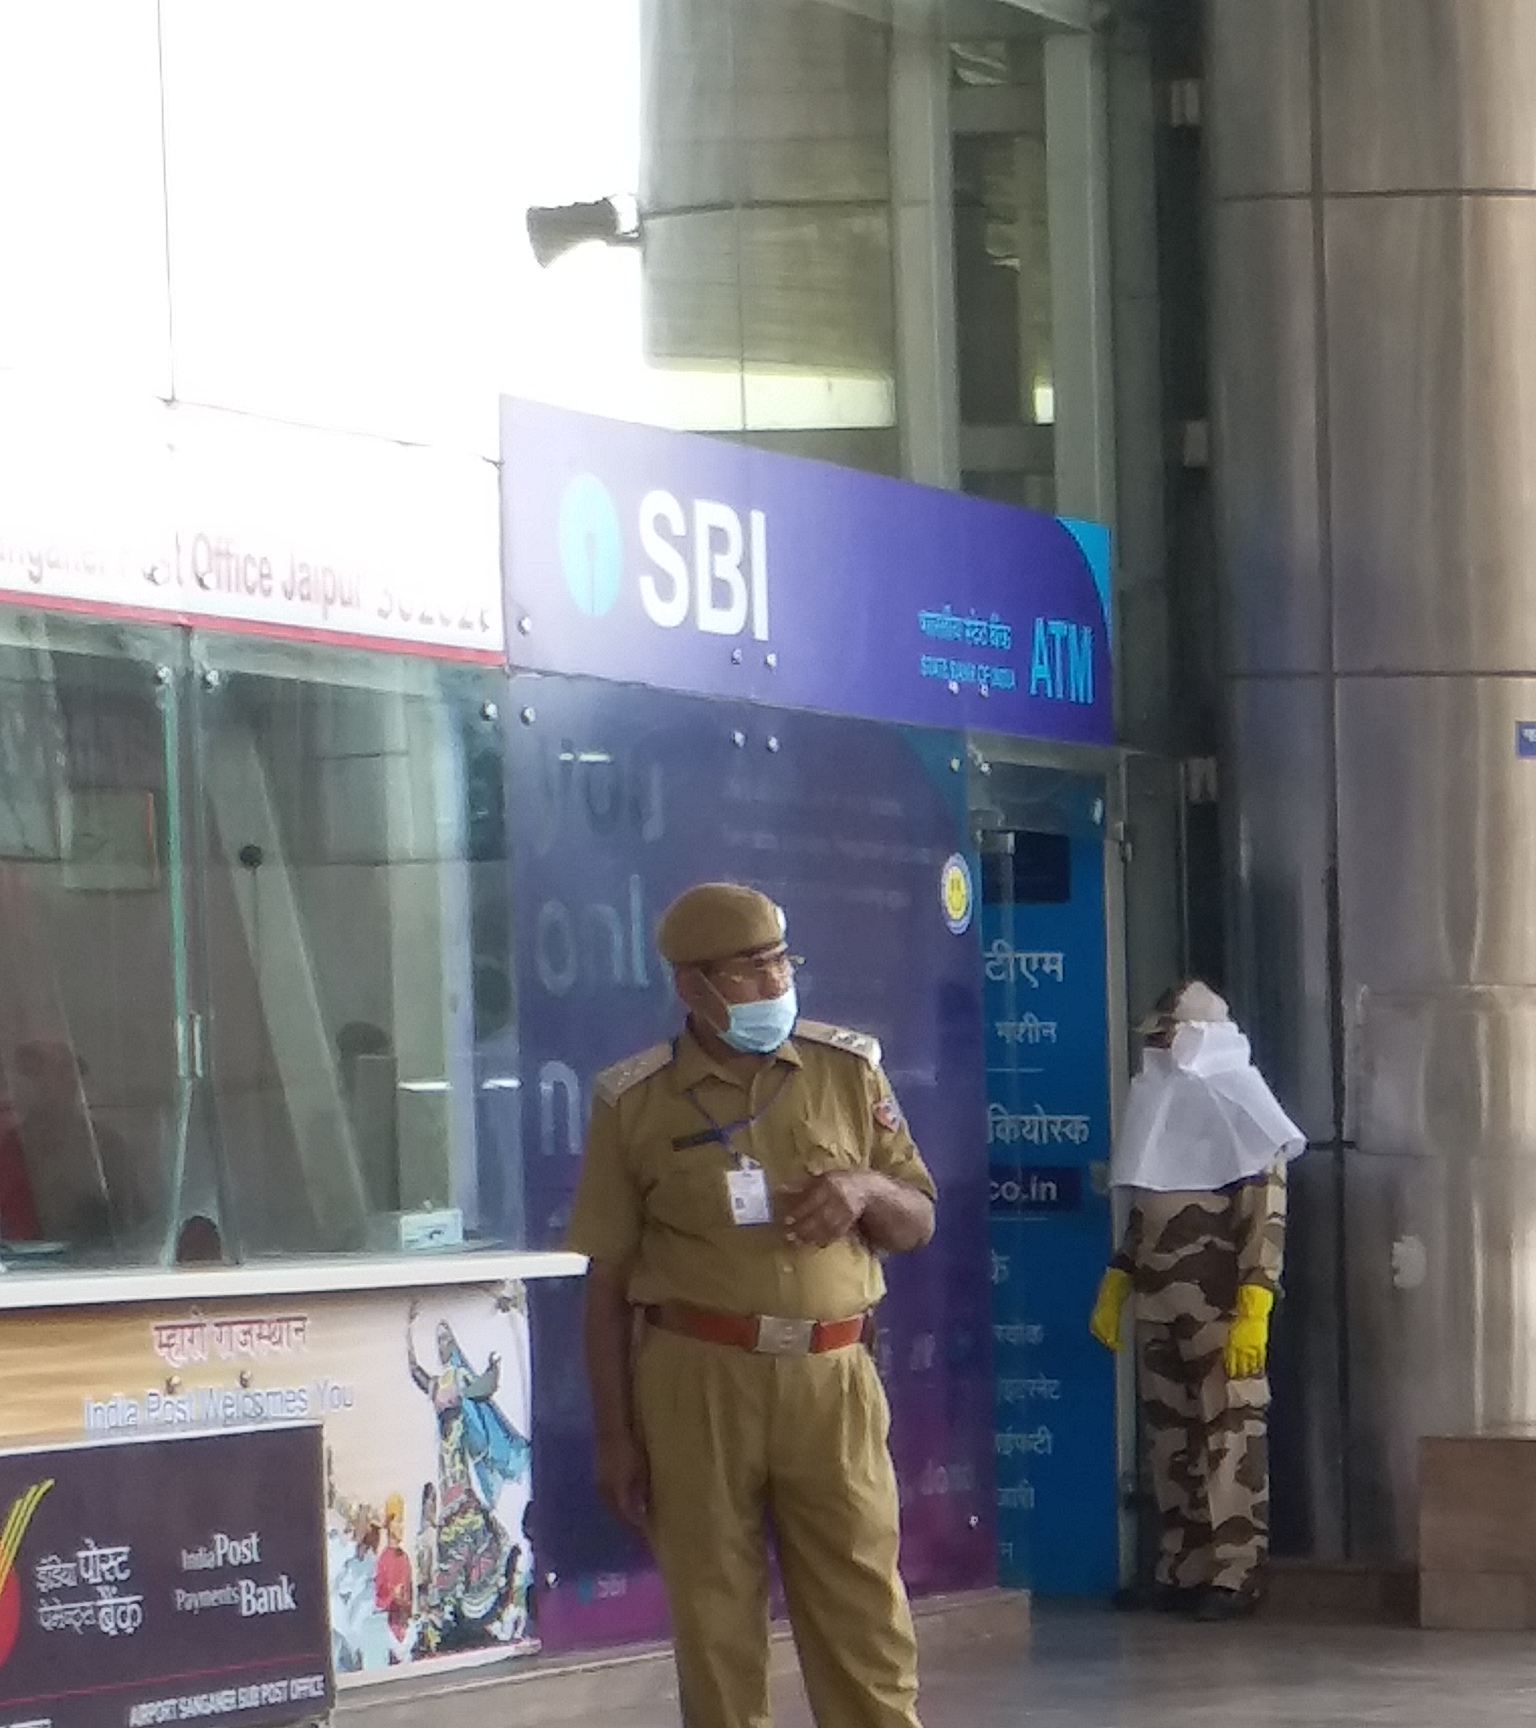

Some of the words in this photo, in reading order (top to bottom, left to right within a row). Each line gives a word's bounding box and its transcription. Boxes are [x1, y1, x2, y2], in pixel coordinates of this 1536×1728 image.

[638, 488, 769, 642] SBI
[1030, 617, 1093, 704] ATM
[85, 1393, 139, 1429] India
[146, 1388, 198, 1424] Post
[315, 1376, 354, 1413] You
[181, 1549, 216, 1571] India
[214, 1531, 262, 1567] Post
[239, 1574, 297, 1617] Bank
